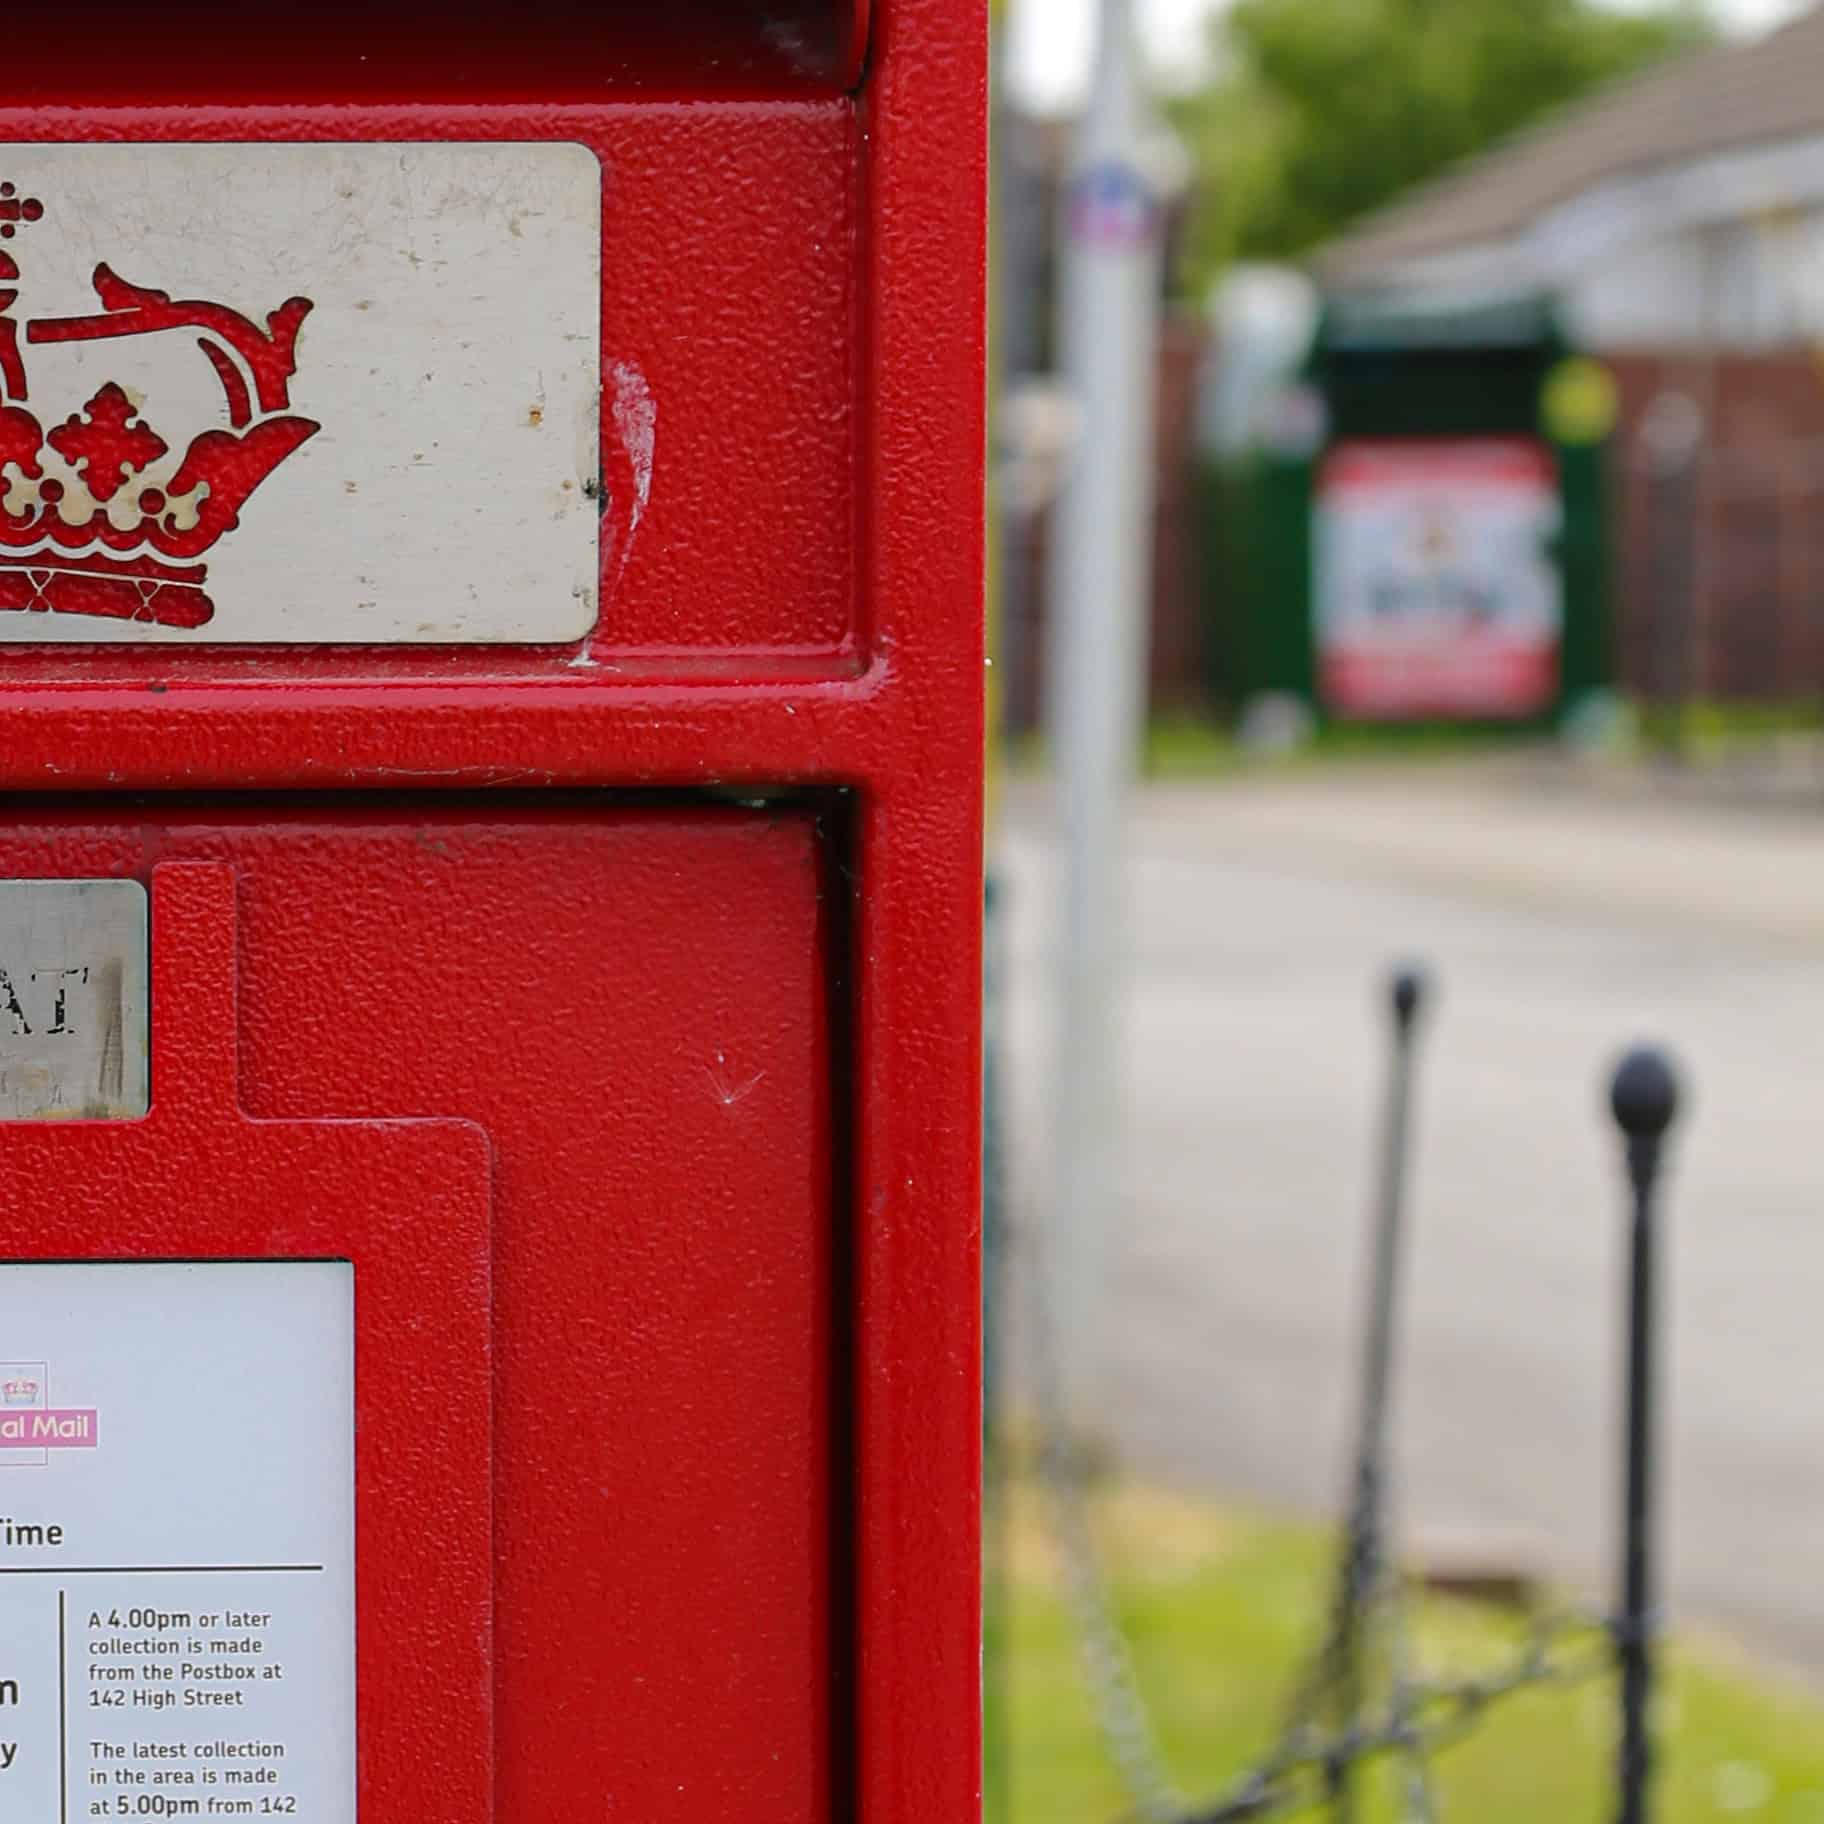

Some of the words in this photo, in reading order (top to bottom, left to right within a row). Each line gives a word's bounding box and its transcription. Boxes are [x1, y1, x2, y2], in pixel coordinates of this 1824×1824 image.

[32, 1415, 88, 1438] Mail
[89, 1612, 100, 1628] A
[108, 1609, 190, 1632] 4.00pm
[199, 1615, 219, 1627] or
[226, 1611, 270, 1627] later
[90, 1638, 179, 1654] collection
[188, 1637, 202, 1653] is
[210, 1638, 261, 1653] made
[89, 1664, 134, 1680] from
[143, 1664, 172, 1680] the
[182, 1663, 255, 1679] Postbox
[263, 1665, 281, 1678] at
[90, 1690, 124, 1706] 142
[134, 1690, 175, 1709] High
[184, 1689, 242, 1705] Street
[90, 1742, 125, 1758] The
[134, 1743, 186, 1758] latest
[194, 1741, 283, 1757] collection
[91, 1768, 107, 1784] in
[115, 1769, 145, 1784] the
[153, 1772, 194, 1784] area
[203, 1768, 216, 1783] is
[225, 1768, 276, 1783] made
[91, 1800, 109, 1814] at
[118, 1795, 199, 1817] 5.00pm
[208, 1797, 252, 1813] from
[261, 1797, 295, 1813] 142
